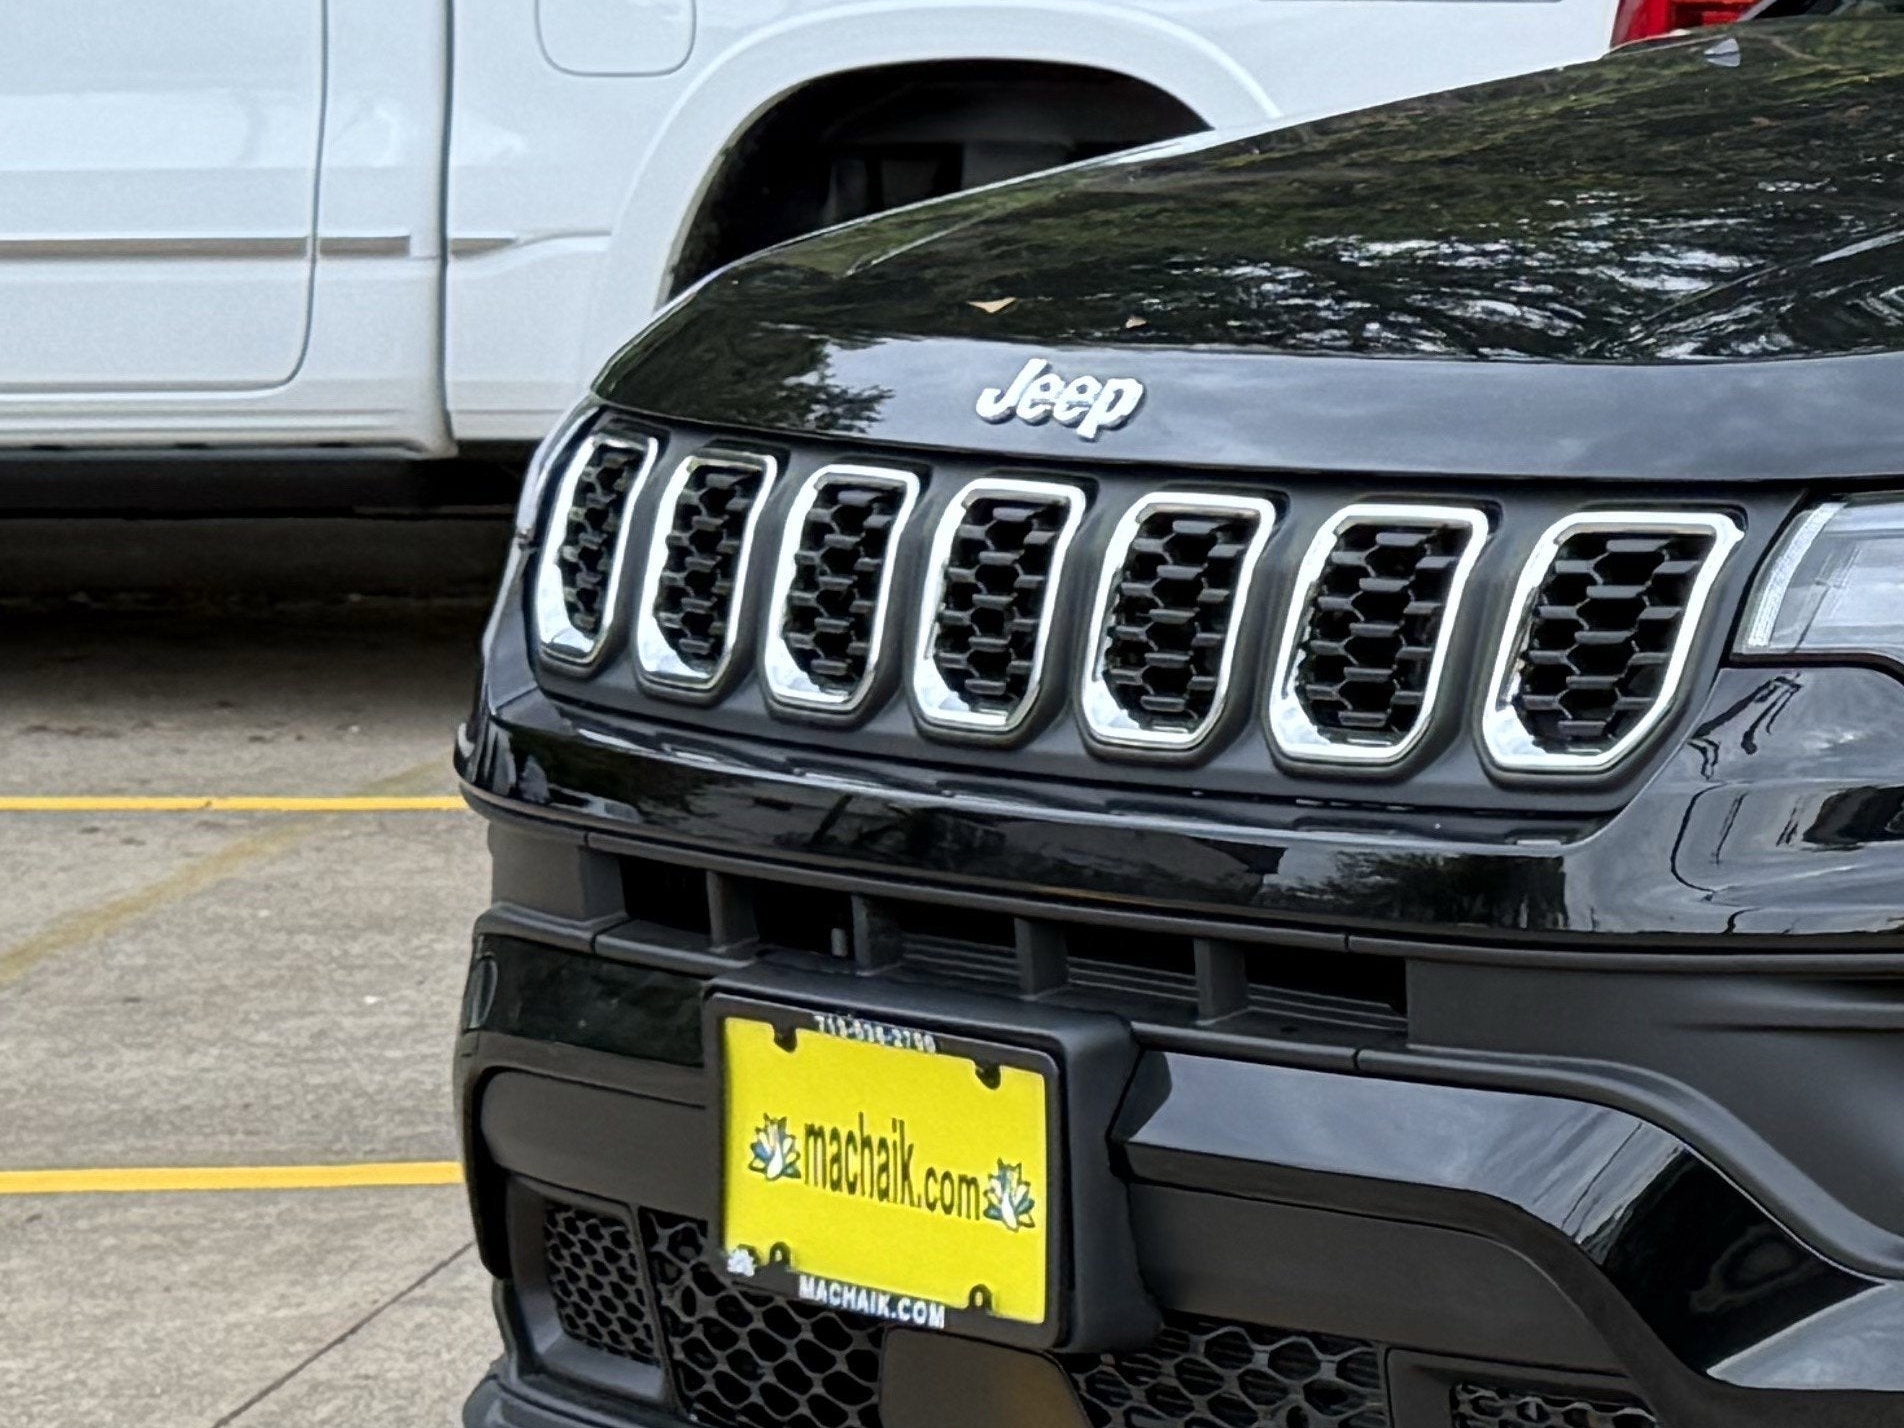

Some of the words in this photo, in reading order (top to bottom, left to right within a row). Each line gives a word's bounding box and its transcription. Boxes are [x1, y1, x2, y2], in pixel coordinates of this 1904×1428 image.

[976, 358, 1145, 440] Jeep
[804, 1112, 980, 1220] machaik.com
[799, 1275, 944, 1328] MACHAIK.COM
